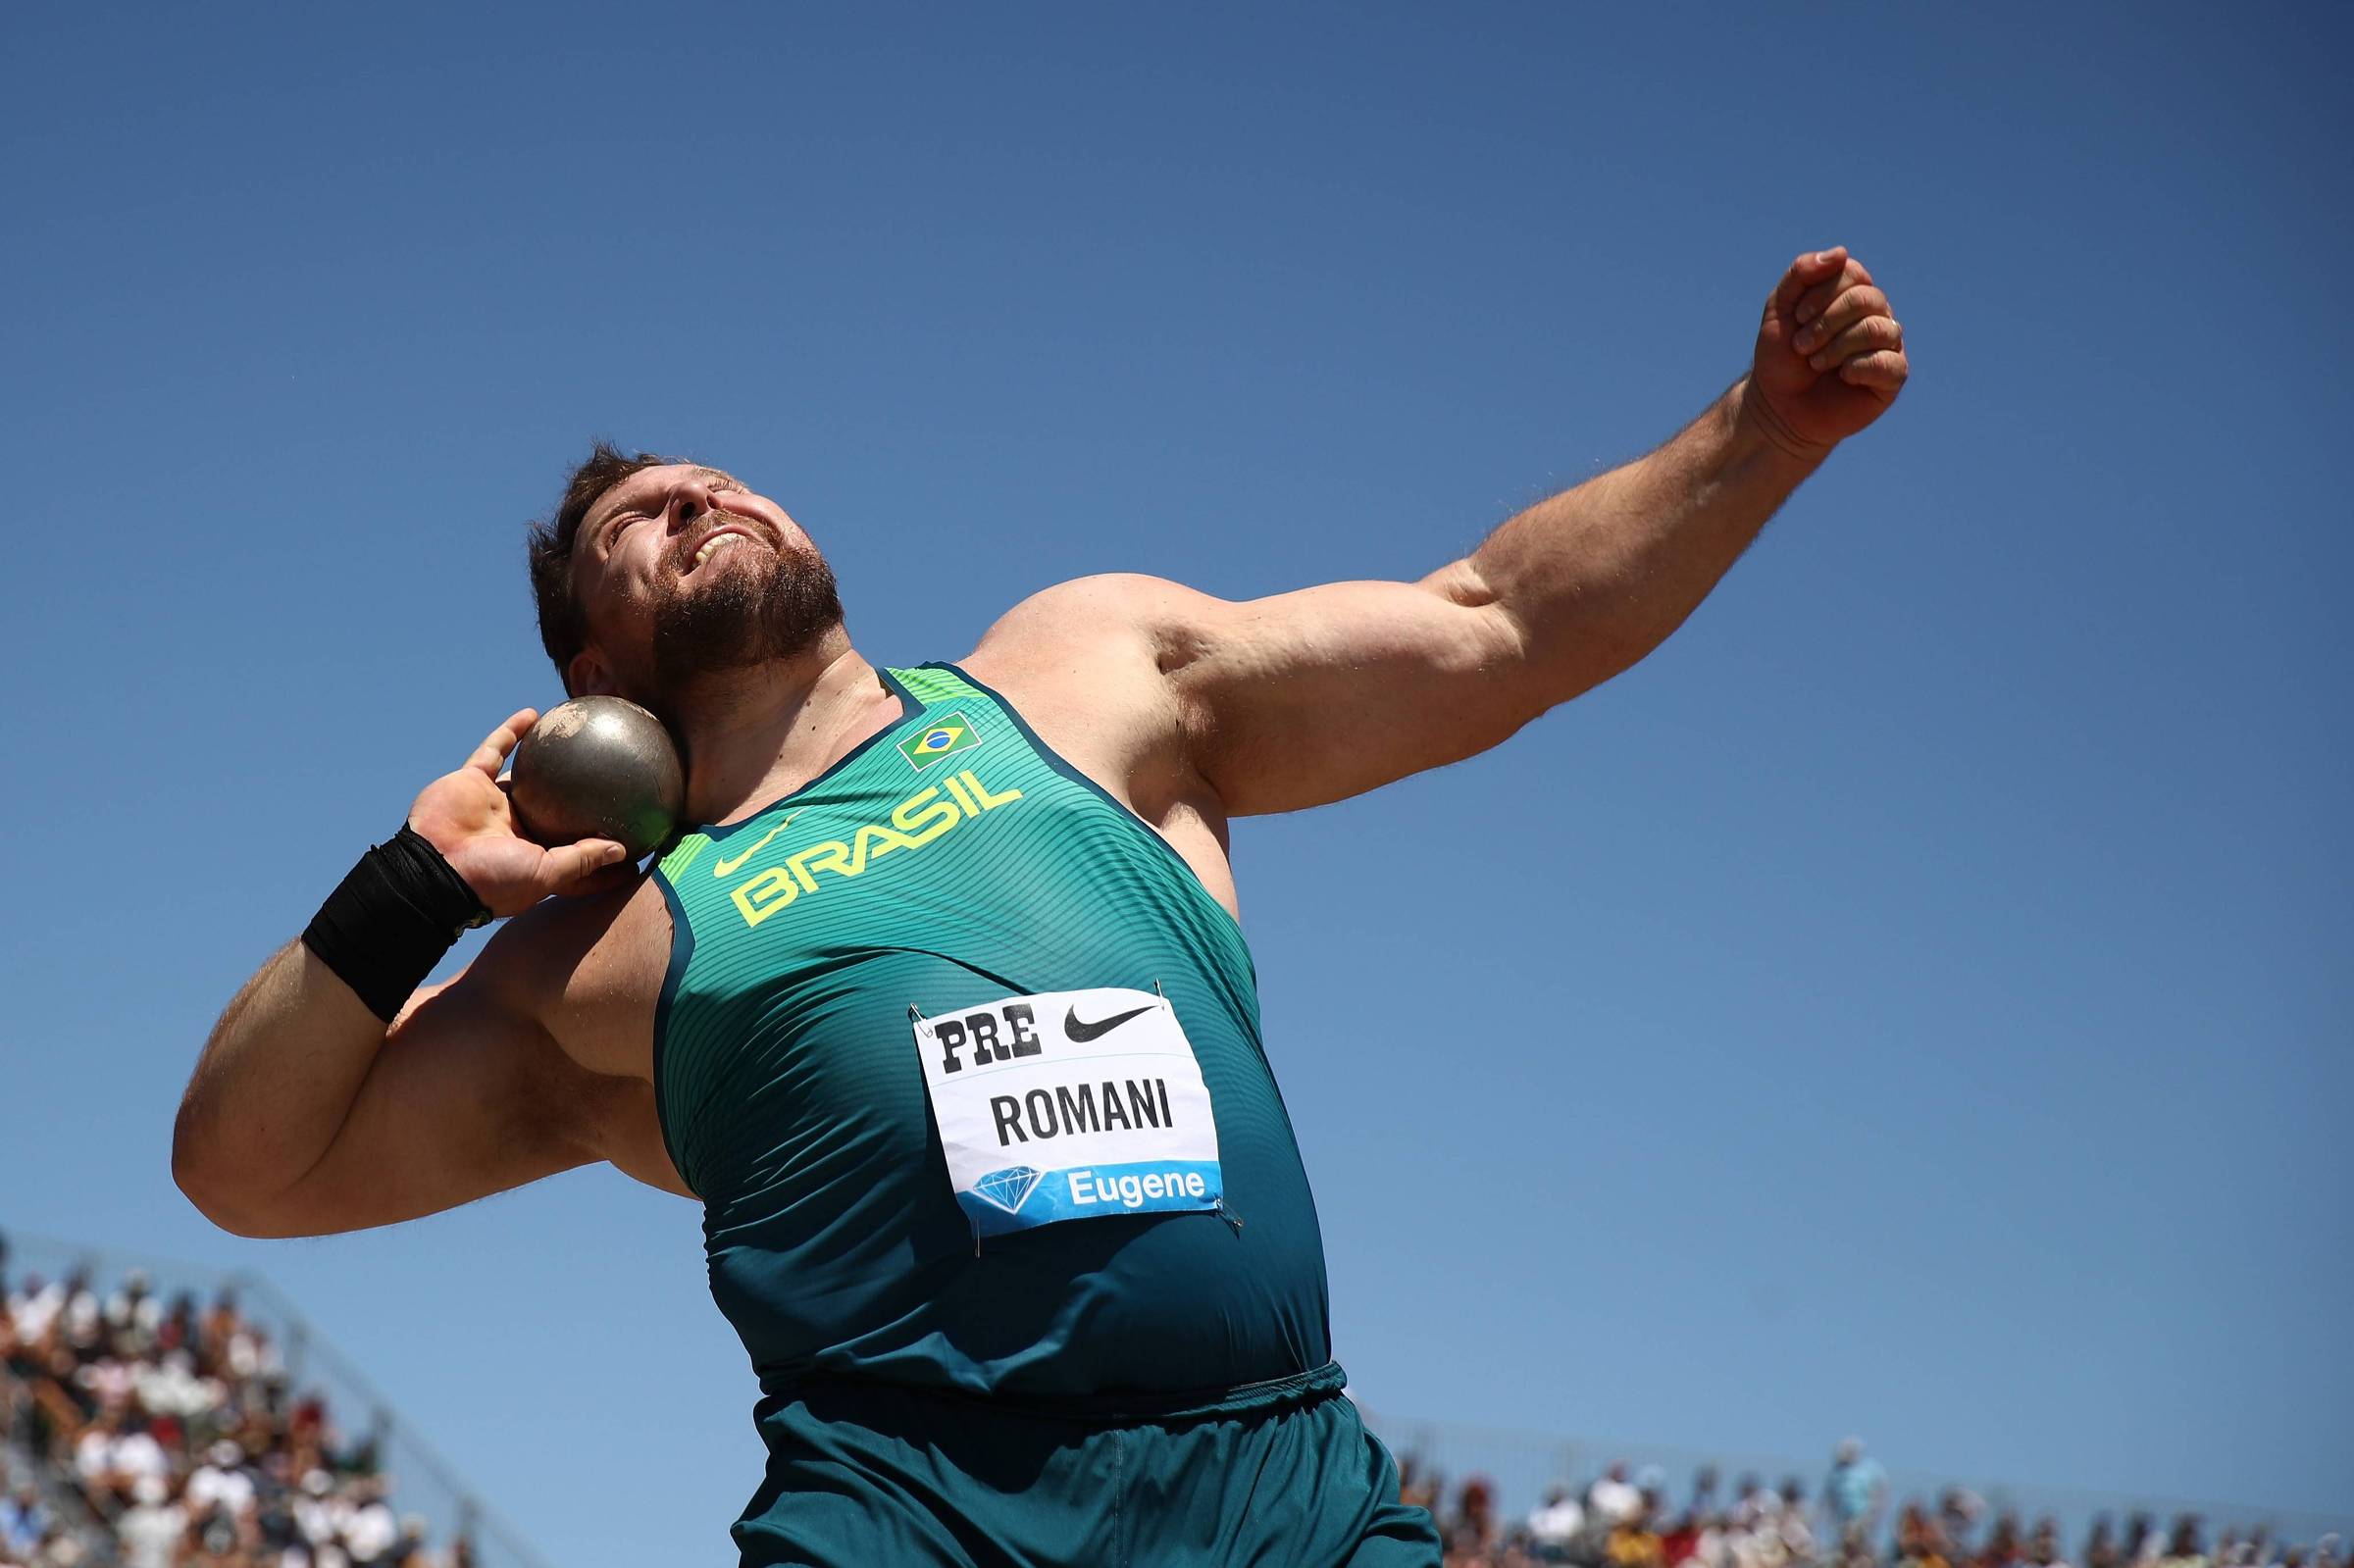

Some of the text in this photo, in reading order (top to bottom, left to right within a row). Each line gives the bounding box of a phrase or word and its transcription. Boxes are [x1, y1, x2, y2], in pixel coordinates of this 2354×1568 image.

[730, 770, 1023, 928] BRASIL
[935, 1003, 1042, 1074] PRE
[990, 1079, 1173, 1146] ROMANI
[1067, 1170, 1205, 1208] Eugene
